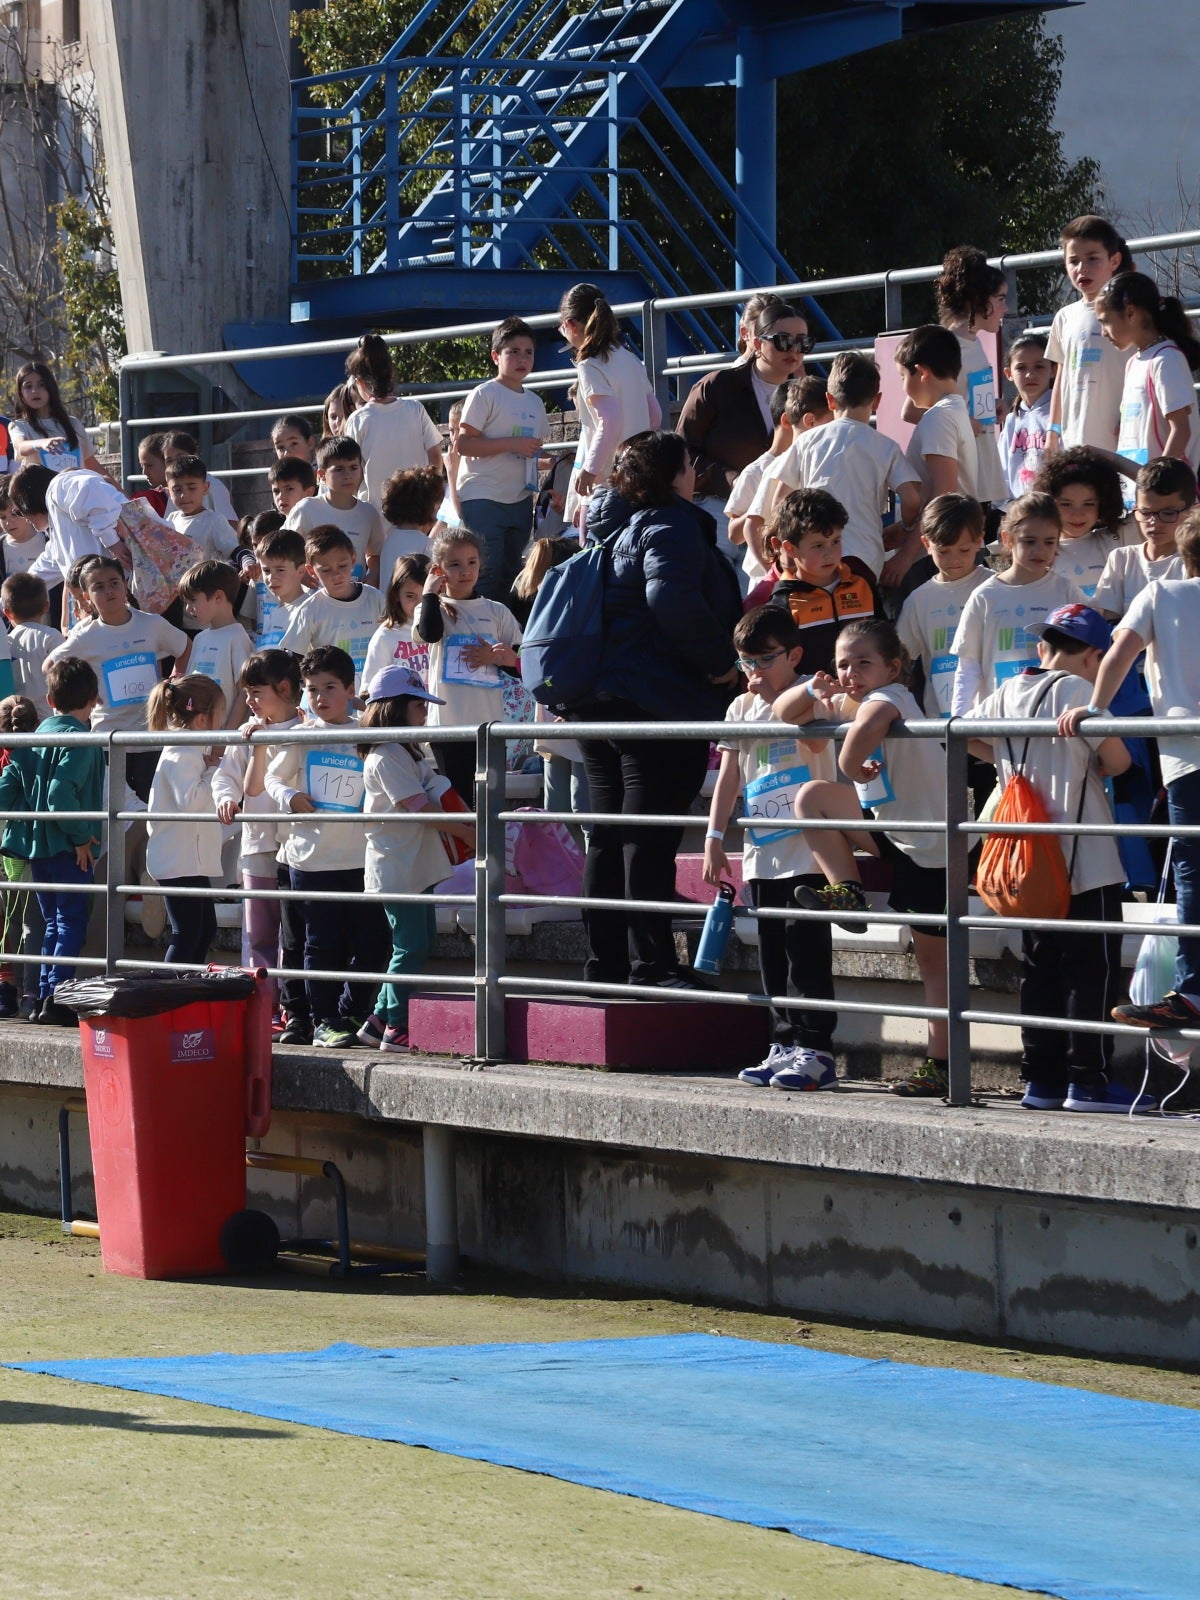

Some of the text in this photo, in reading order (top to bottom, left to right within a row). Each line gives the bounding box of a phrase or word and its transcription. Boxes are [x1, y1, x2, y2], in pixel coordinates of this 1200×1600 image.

[115, 655, 138, 668] unicef
[937, 659, 958, 670] unice
[321, 755, 349, 766] unicef
[317, 772, 355, 799] 115
[753, 775, 779, 793] unicef
[177, 1048, 209, 1058] IMDECO
